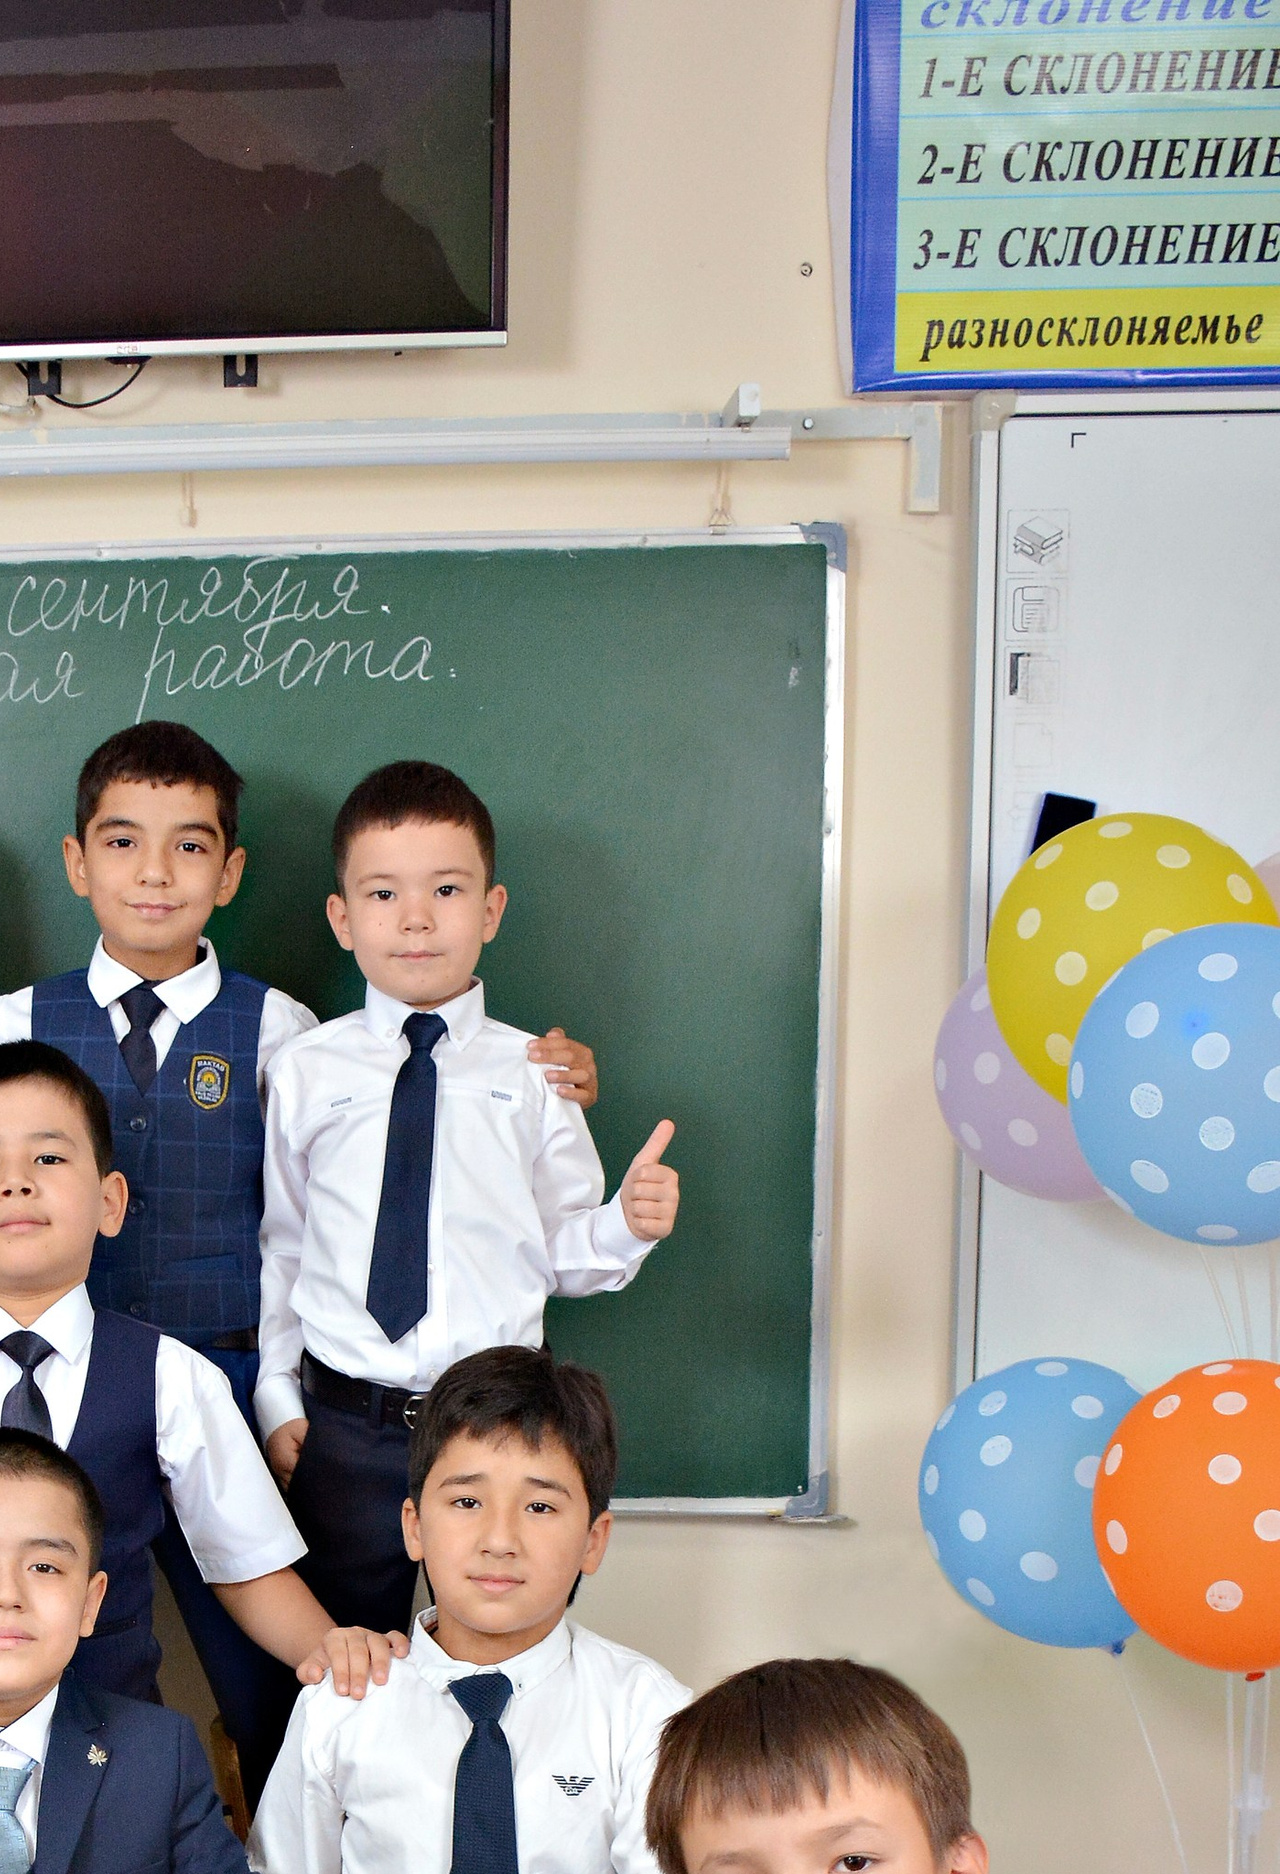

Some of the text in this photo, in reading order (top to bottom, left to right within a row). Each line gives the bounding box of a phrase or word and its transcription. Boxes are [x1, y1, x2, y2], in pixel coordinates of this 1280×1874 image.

[920, 57, 987, 98] 1-Е
[918, 137, 1280, 185] 2-Е СКЛОНЕНИЕ
[913, 223, 1280, 270] 3-Е СКЛОНЕНИЕ
